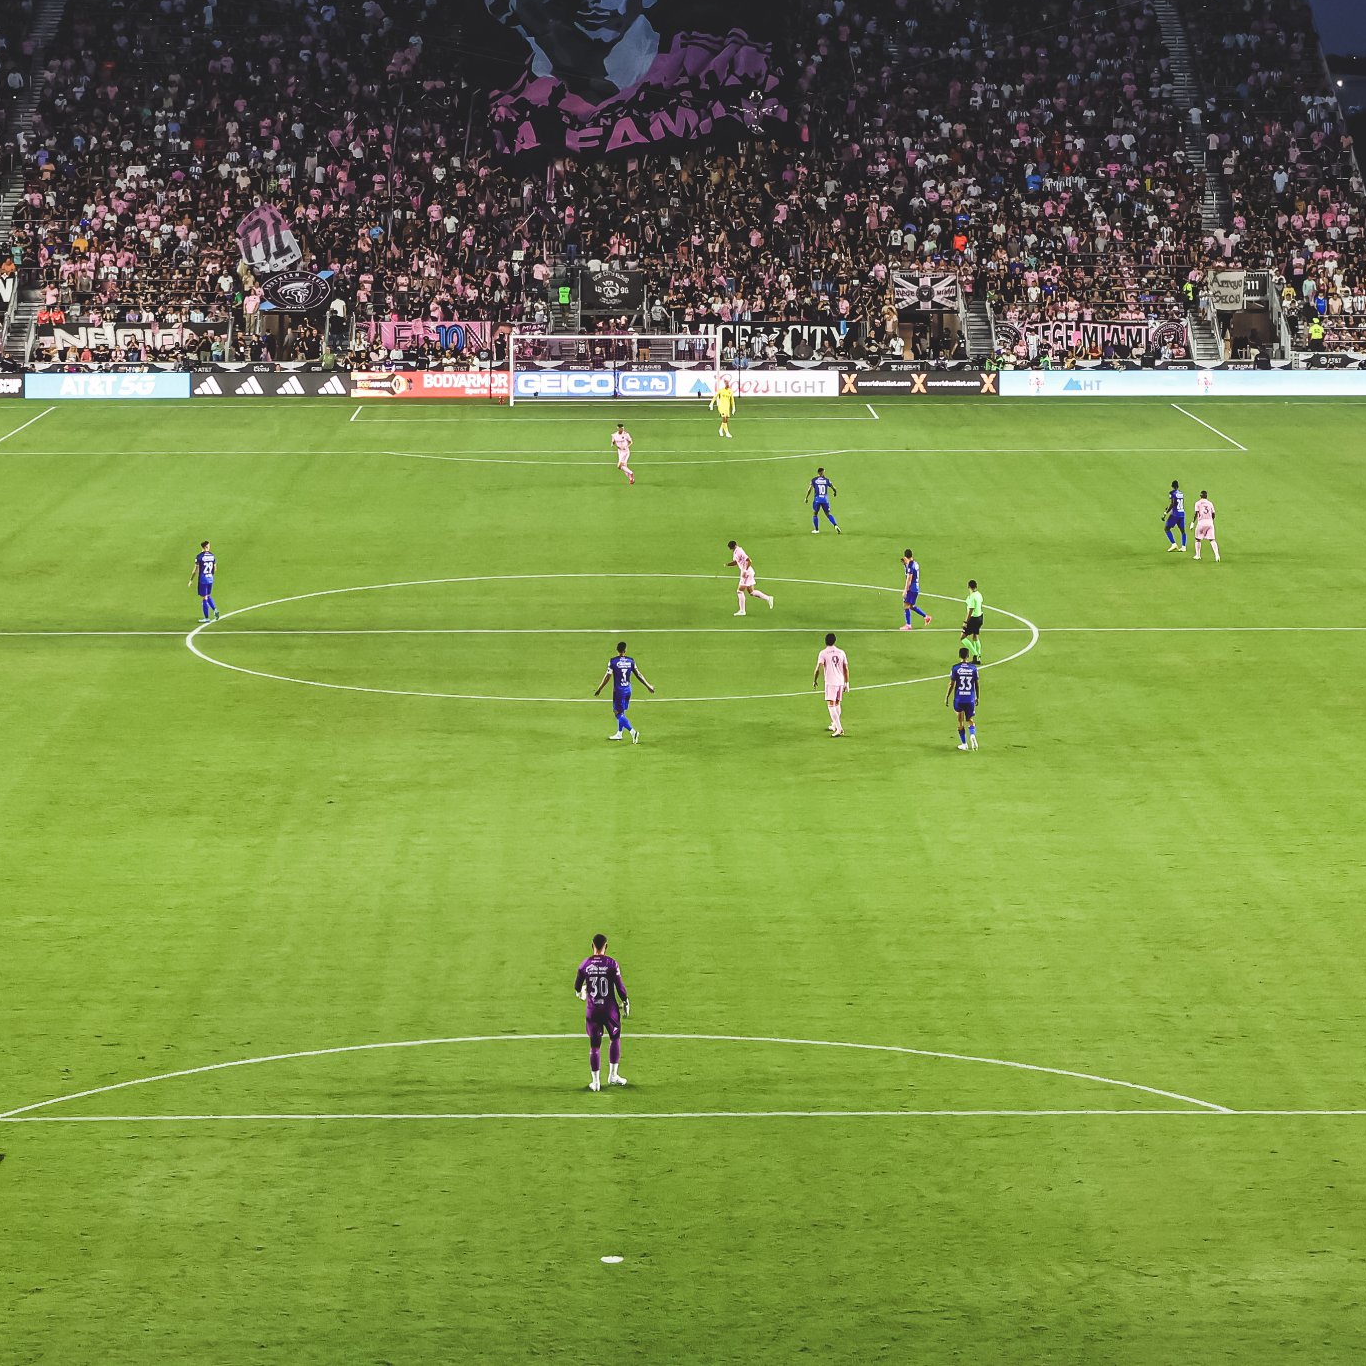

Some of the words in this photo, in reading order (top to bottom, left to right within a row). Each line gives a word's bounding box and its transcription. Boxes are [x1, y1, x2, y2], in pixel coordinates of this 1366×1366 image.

[1246, 280, 1259, 290] 111
[59, 374, 117, 396] AT&T
[118, 375, 156, 396] 5G
[423, 373, 509, 389] BODYARMOR
[516, 373, 615, 394] GEICO
[774, 380, 827, 394] LIGHT
[464, 387, 488, 396] Sports
[817, 484, 826, 495] 10
[1203, 505, 1209, 515] 3
[203, 562, 214, 575] 29
[831, 655, 840, 667] 9
[621, 668, 627, 682] 3
[958, 676, 972, 691] 33
[588, 976, 609, 998] 30
